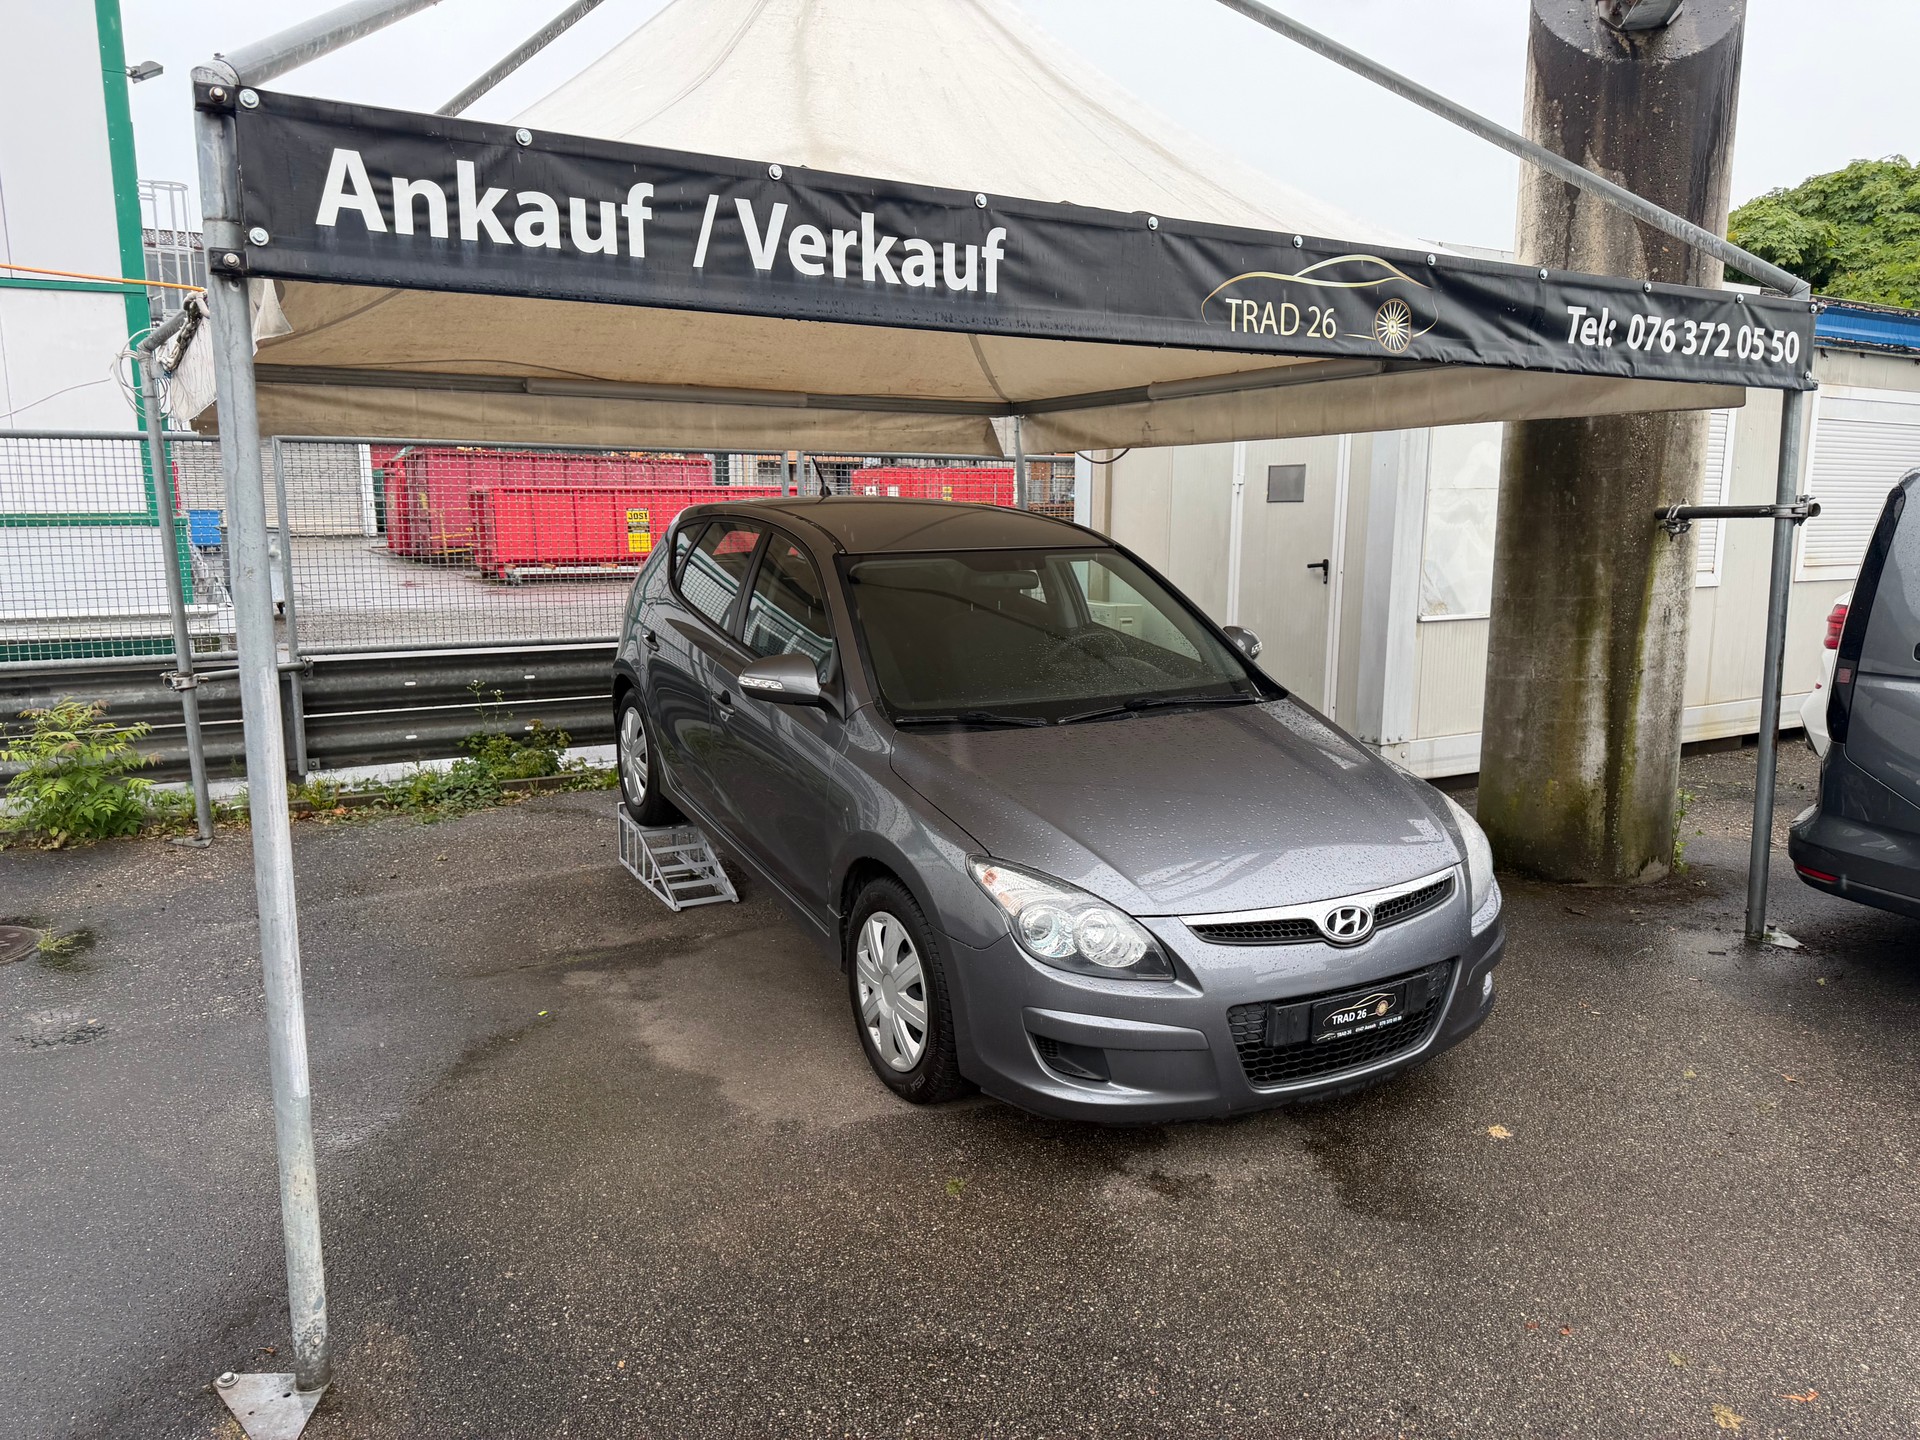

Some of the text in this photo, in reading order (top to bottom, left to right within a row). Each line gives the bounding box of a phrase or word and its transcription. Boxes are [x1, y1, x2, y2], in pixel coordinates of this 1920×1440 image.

[315, 147, 655, 259] Ankauf
[733, 197, 1007, 294] Verkauf
[1225, 297, 1337, 339] TRAD 26
[1567, 305, 1800, 364] Tel: 076 372 05 50
[1332, 1008, 1367, 1025] TRAD 26
